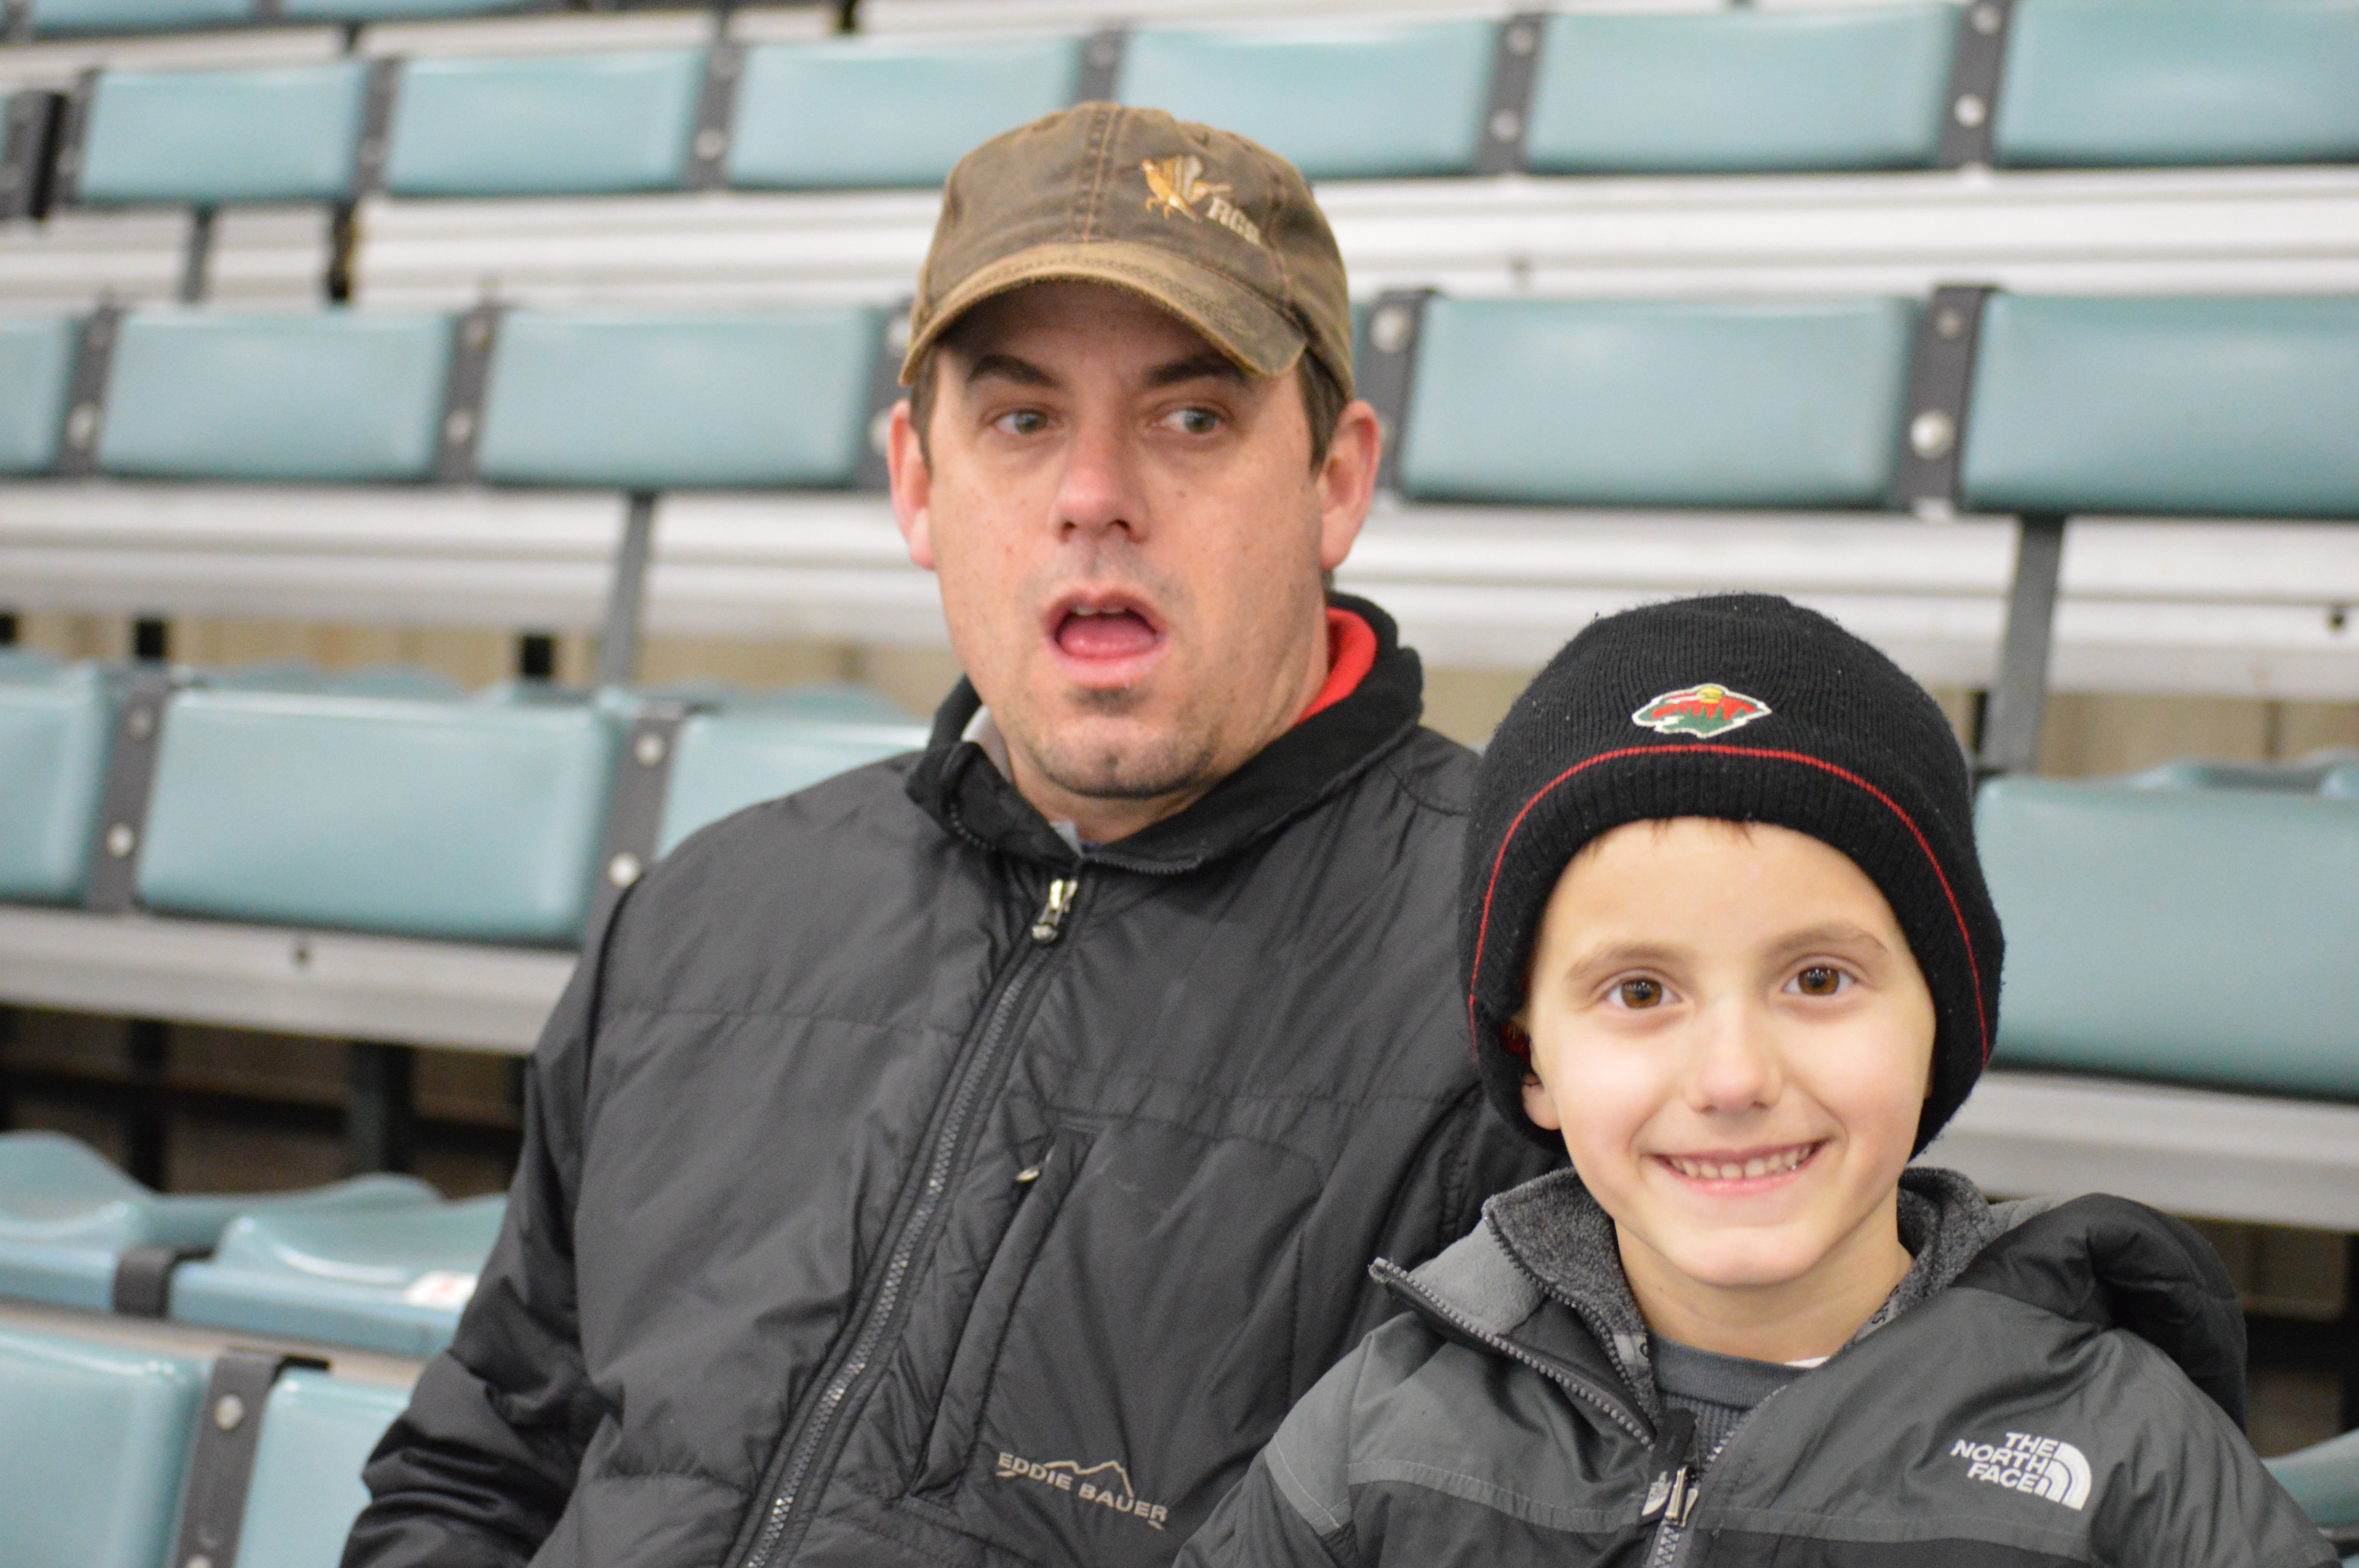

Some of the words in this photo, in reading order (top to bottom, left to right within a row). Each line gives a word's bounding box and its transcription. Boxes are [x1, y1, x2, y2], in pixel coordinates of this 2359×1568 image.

[1949, 1438, 2049, 1475] NORTH
[2005, 1431, 2059, 1459] THE
[998, 1452, 1073, 1491] EDDIE
[1078, 1482, 1168, 1523] BAUER
[1966, 1461, 2039, 1494] FACE
